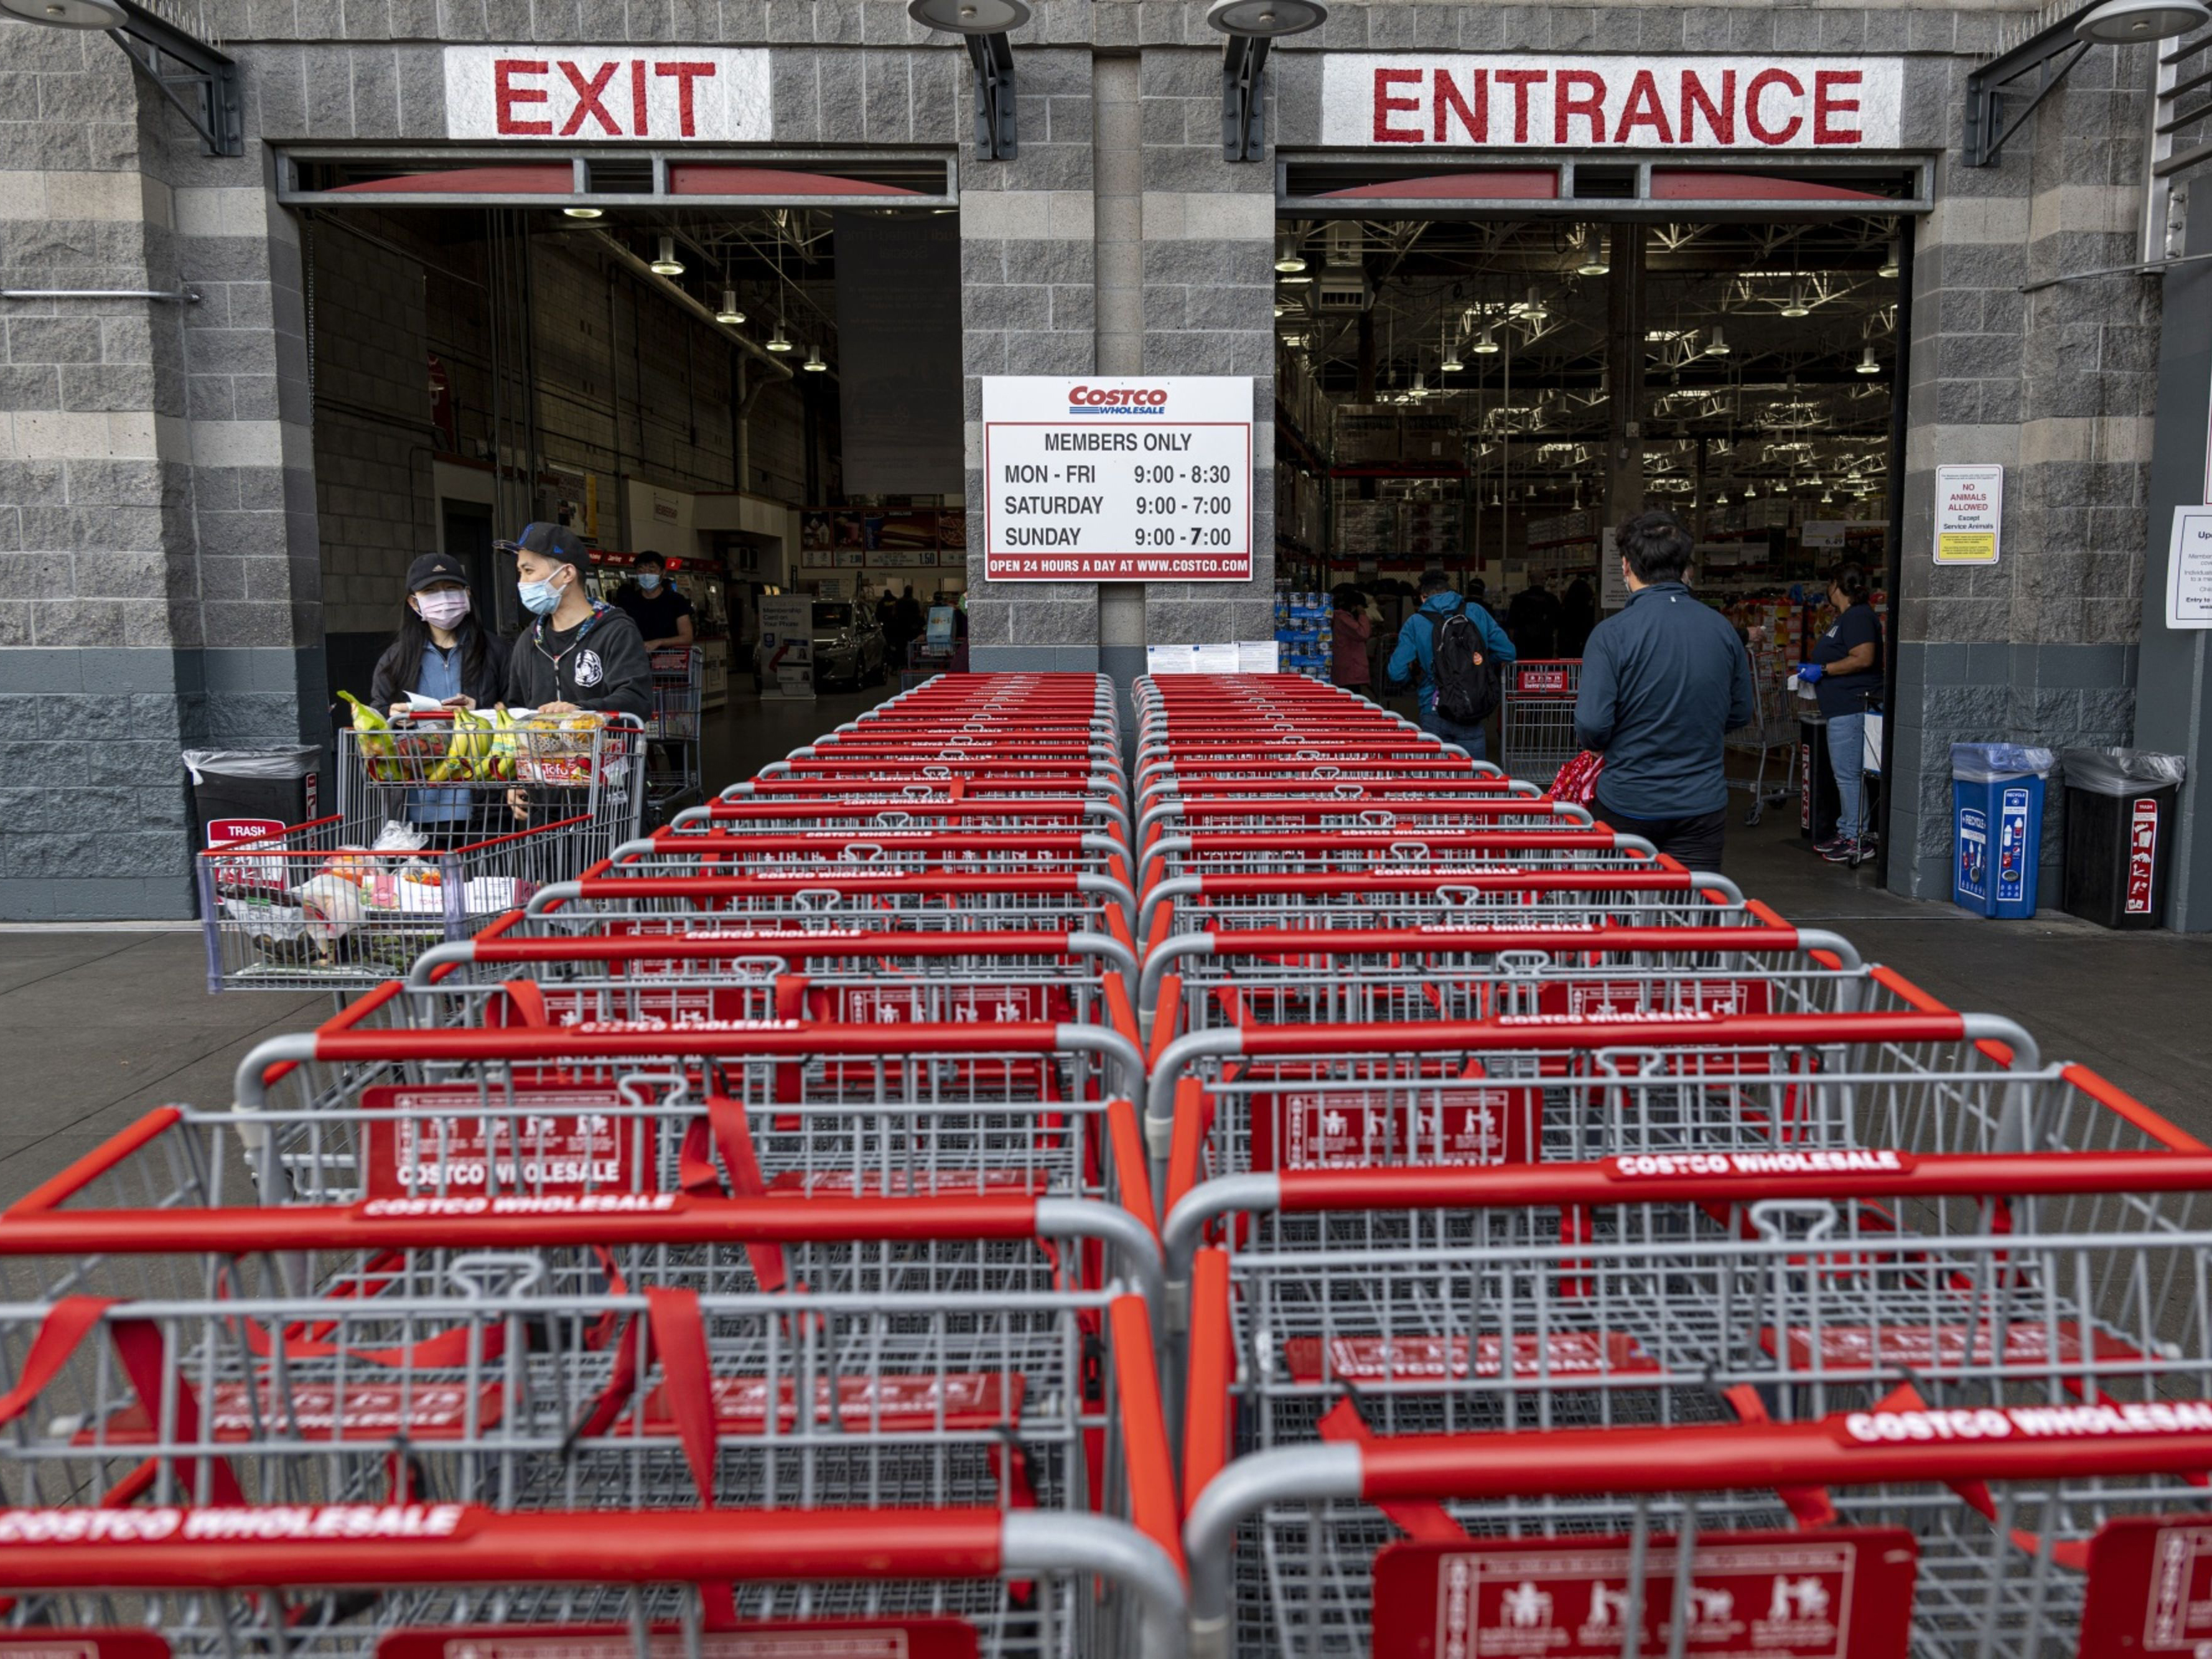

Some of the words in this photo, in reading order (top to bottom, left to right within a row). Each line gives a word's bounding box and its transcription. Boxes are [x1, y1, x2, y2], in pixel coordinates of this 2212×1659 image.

[495, 60, 716, 138] EXIT
[1373, 68, 1863, 145] ENTRANCE
[1068, 386, 1168, 406] COSTCO
[1099, 406, 1165, 414] WHOLESALE
[1045, 433, 1137, 451] MEMBERS
[1144, 433, 1192, 451] ONLY
[1005, 465, 1048, 484] MON
[1066, 465, 1096, 483] FRI
[1135, 465, 1174, 484] 9:00
[1191, 465, 1231, 484] 8:30
[1005, 496, 1104, 515] SATURDAY
[1136, 497, 1176, 515] 9:00
[1193, 497, 1231, 515] 7:00
[1005, 527, 1081, 546] SUNDAY
[1135, 528, 1175, 546] 9:00
[1190, 528, 1231, 546] 7:00
[919, 553, 935, 564] 1.50
[990, 559, 1020, 572] OPEN
[1023, 559, 1038, 571] 24
[1041, 559, 1079, 572] HOURS
[1083, 559, 1090, 571] A
[1094, 559, 1116, 571] DAY
[1120, 559, 1134, 571] AT
[1137, 559, 1248, 571] WWW.COSTCO.COM
[542, 763, 569, 775] Tofu
[228, 826, 266, 836] TRASH
[818, 871, 905, 879] WHOLESALE
[685, 930, 765, 940] COSTCO
[769, 929, 861, 939] WHOLESALE
[1421, 924, 1491, 933] COSTCO
[1494, 923, 1594, 933] WHOLESALE
[1499, 1014, 1582, 1026] COSTCO
[1587, 1011, 1712, 1024] WHOLESALE
[1617, 1153, 1730, 1175] COSTCO
[1734, 1150, 1902, 1173] WHOLESALE
[363, 1197, 503, 1216] COSTCO
[508, 1193, 677, 1213] WHOLESALE
[1846, 1410, 2012, 1442] COSTCO
[184, 1505, 464, 1538] WHOLESALE
